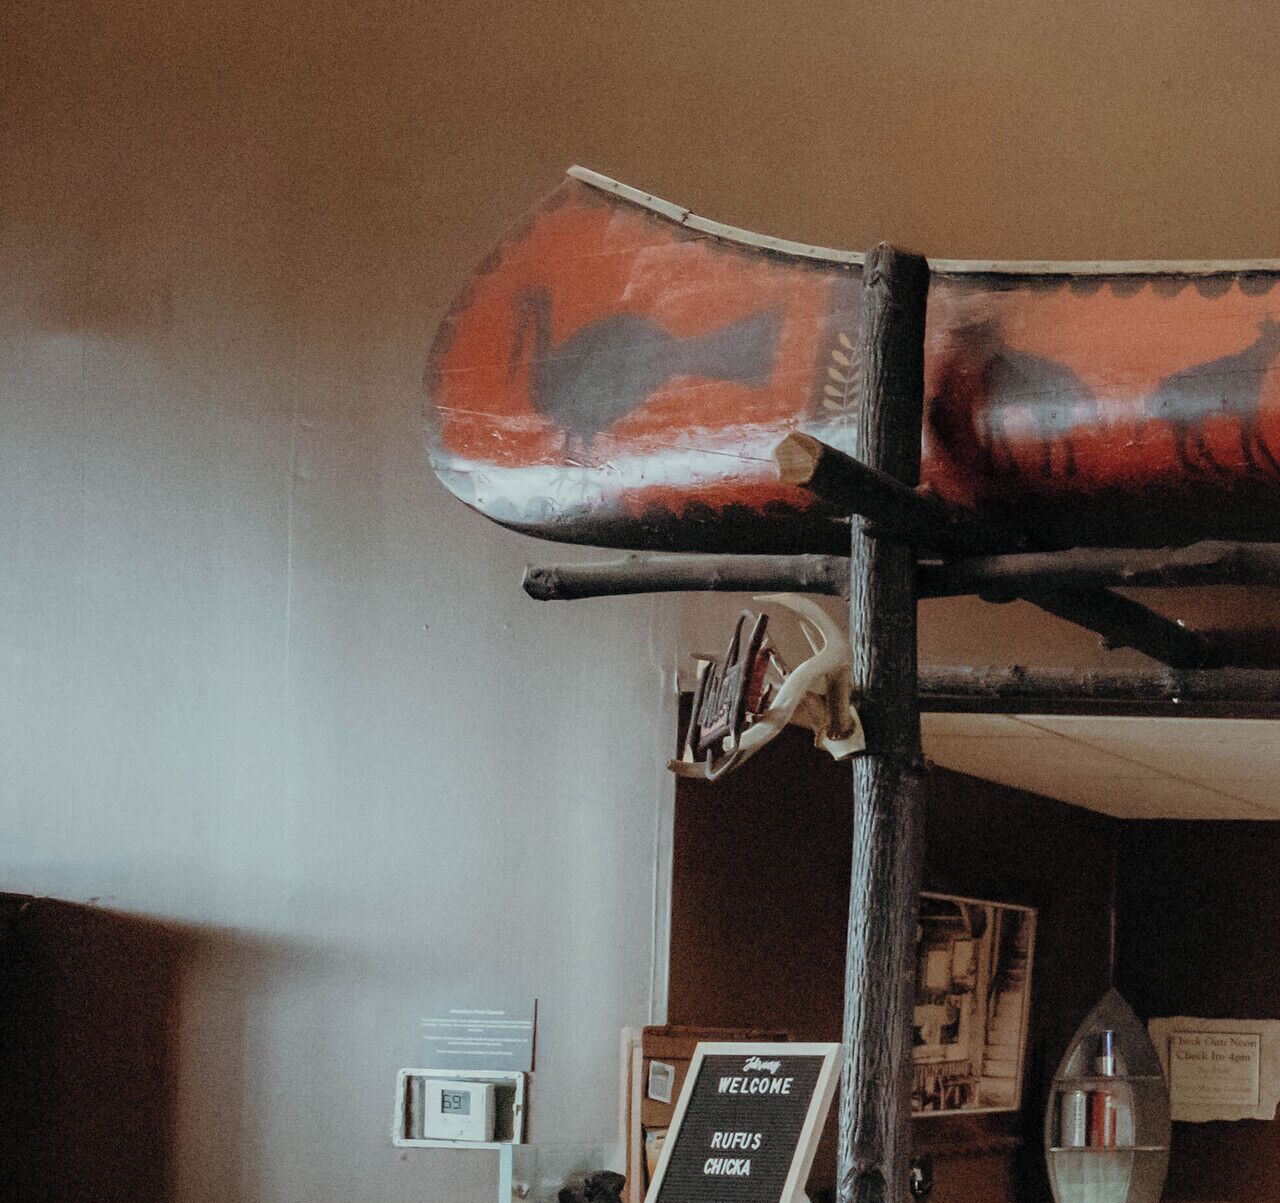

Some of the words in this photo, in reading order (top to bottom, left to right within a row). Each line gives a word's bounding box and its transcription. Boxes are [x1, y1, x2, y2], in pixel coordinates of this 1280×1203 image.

[718, 1077, 794, 1095] WELCOME
[711, 1131, 762, 1150] RUFUS
[703, 1158, 751, 1176] CHICKA
